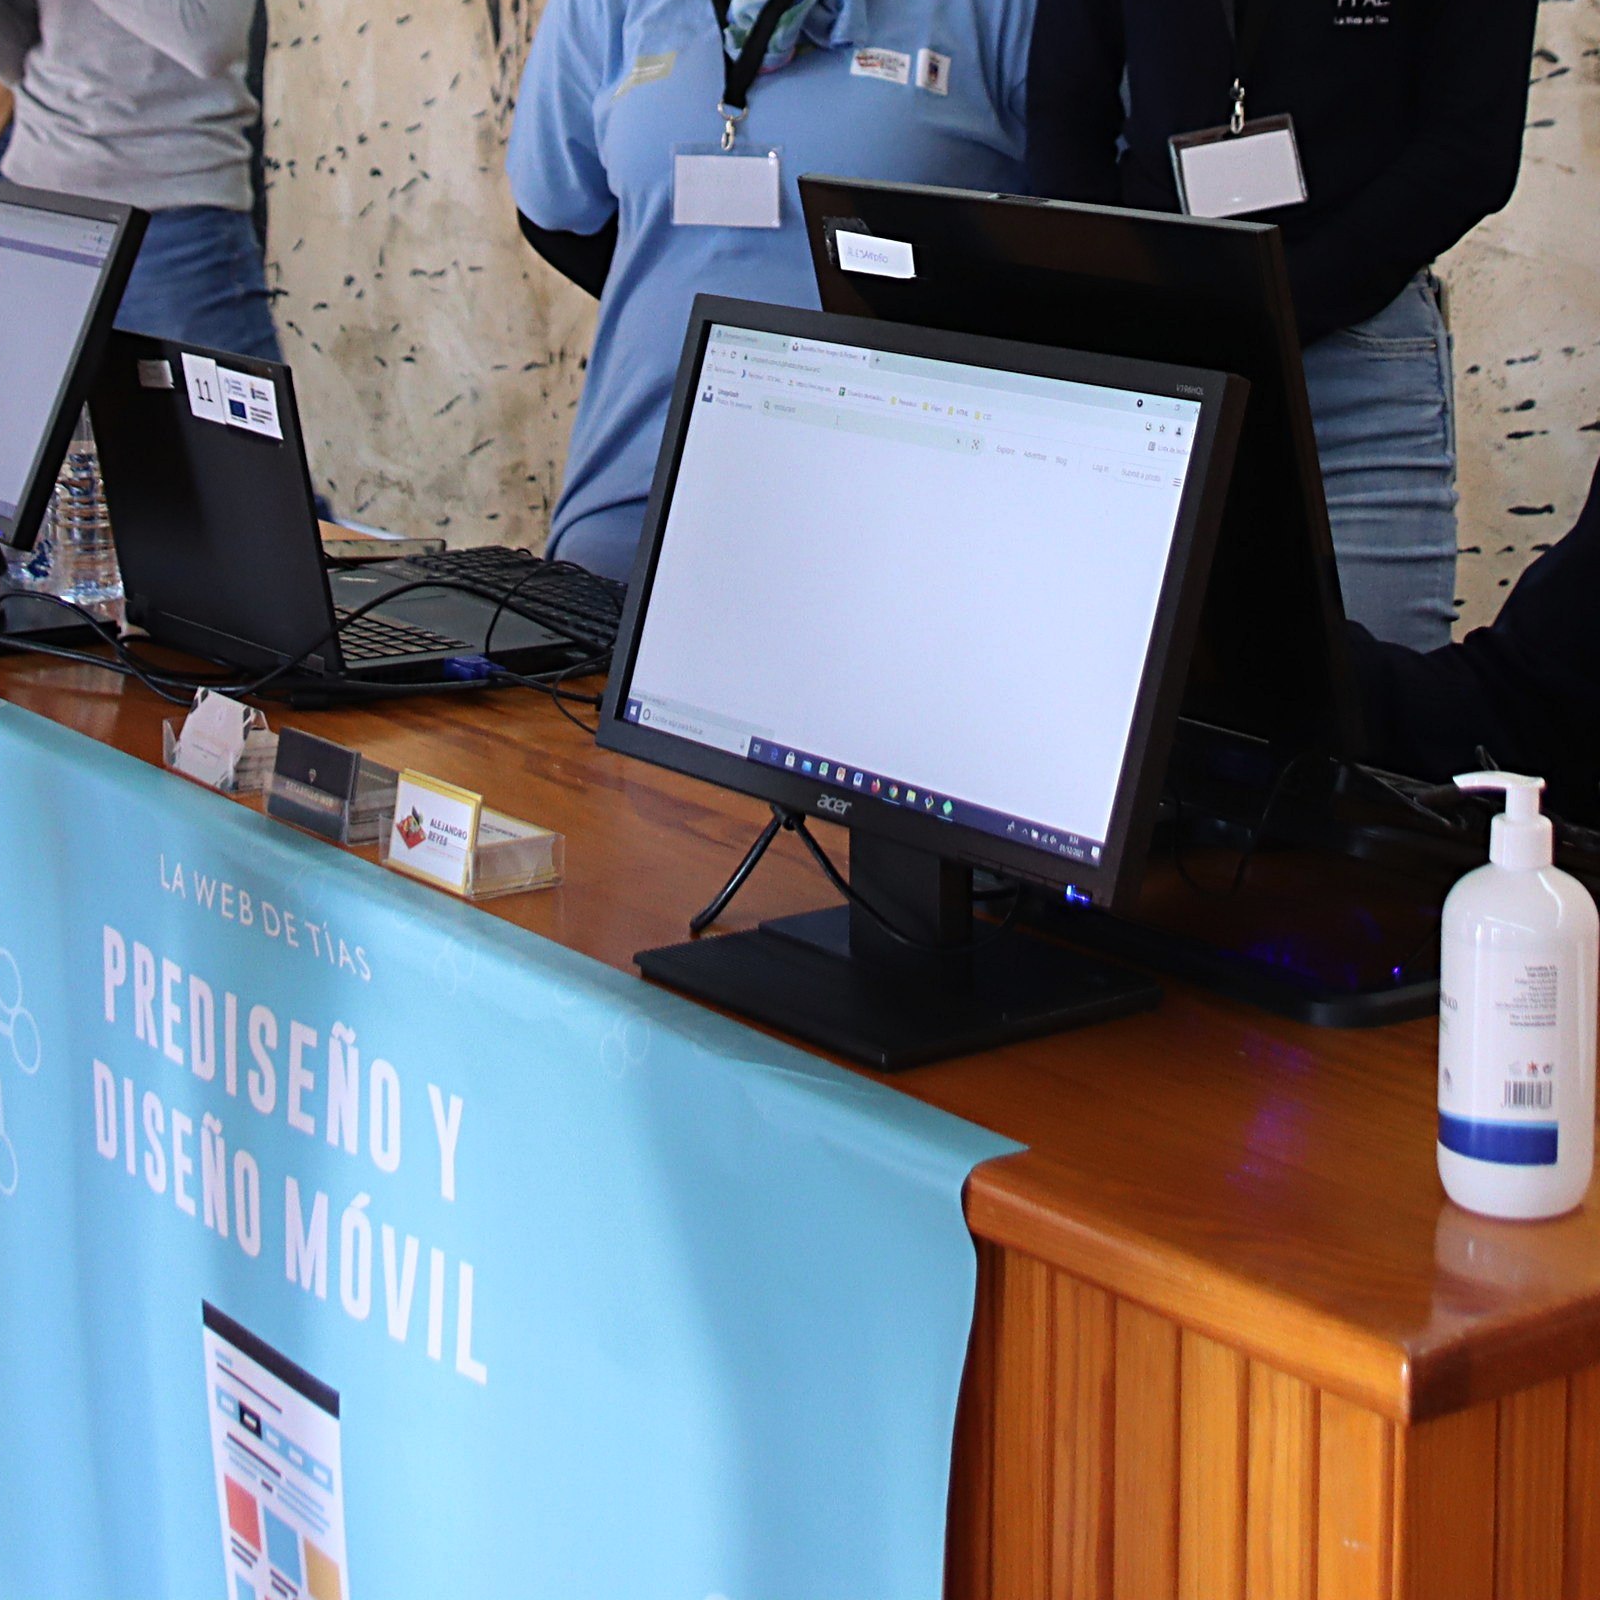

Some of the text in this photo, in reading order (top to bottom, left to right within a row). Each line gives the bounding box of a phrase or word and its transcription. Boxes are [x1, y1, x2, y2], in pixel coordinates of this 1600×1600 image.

[195, 378, 214, 403] 11
[429, 817, 468, 841] ALEJANDRO
[817, 794, 852, 816] acer
[160, 853, 372, 982] LA WEB DE TÍAS
[102, 925, 464, 1201] PREDISEÑO Y
[92, 1058, 488, 1385] DISEÑO MÓVIL
